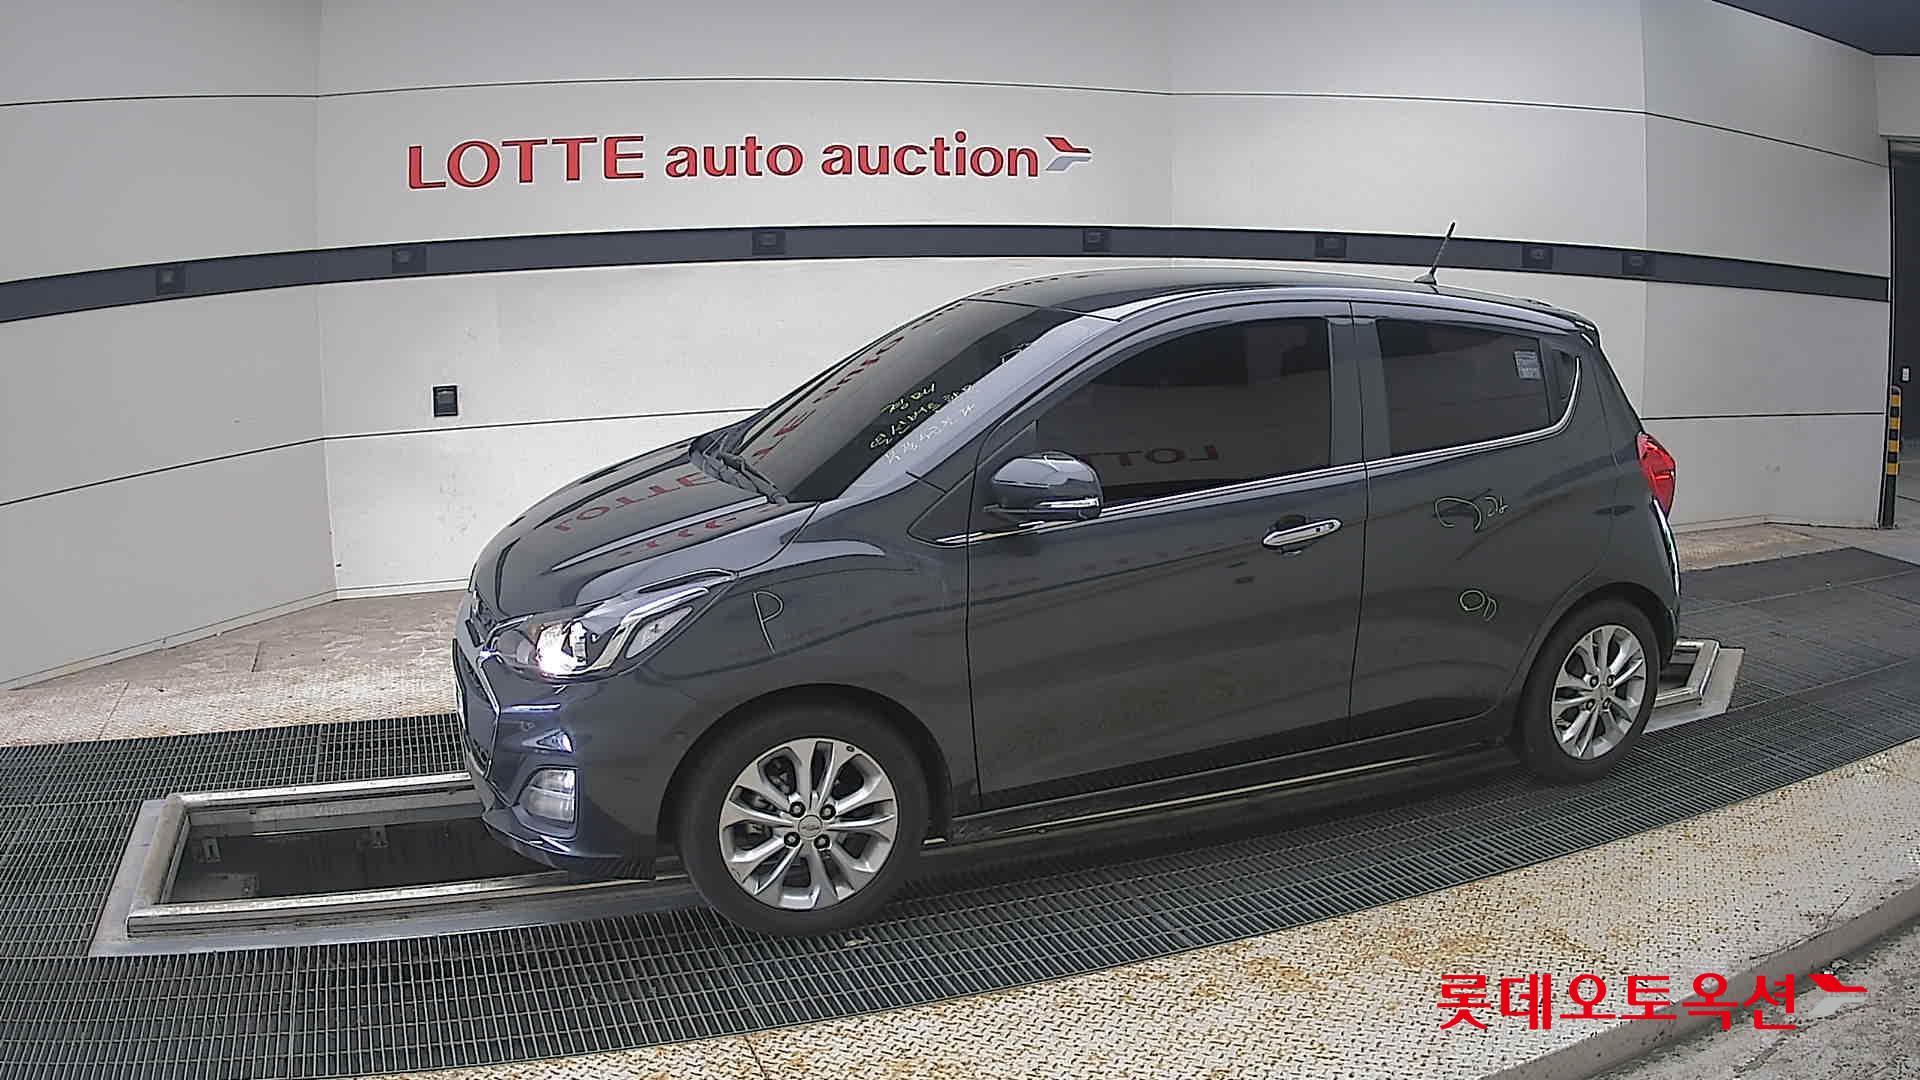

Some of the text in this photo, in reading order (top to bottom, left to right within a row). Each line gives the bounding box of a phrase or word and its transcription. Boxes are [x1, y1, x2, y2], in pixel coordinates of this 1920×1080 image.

[407, 130, 1040, 190] LOTTE auto auction
